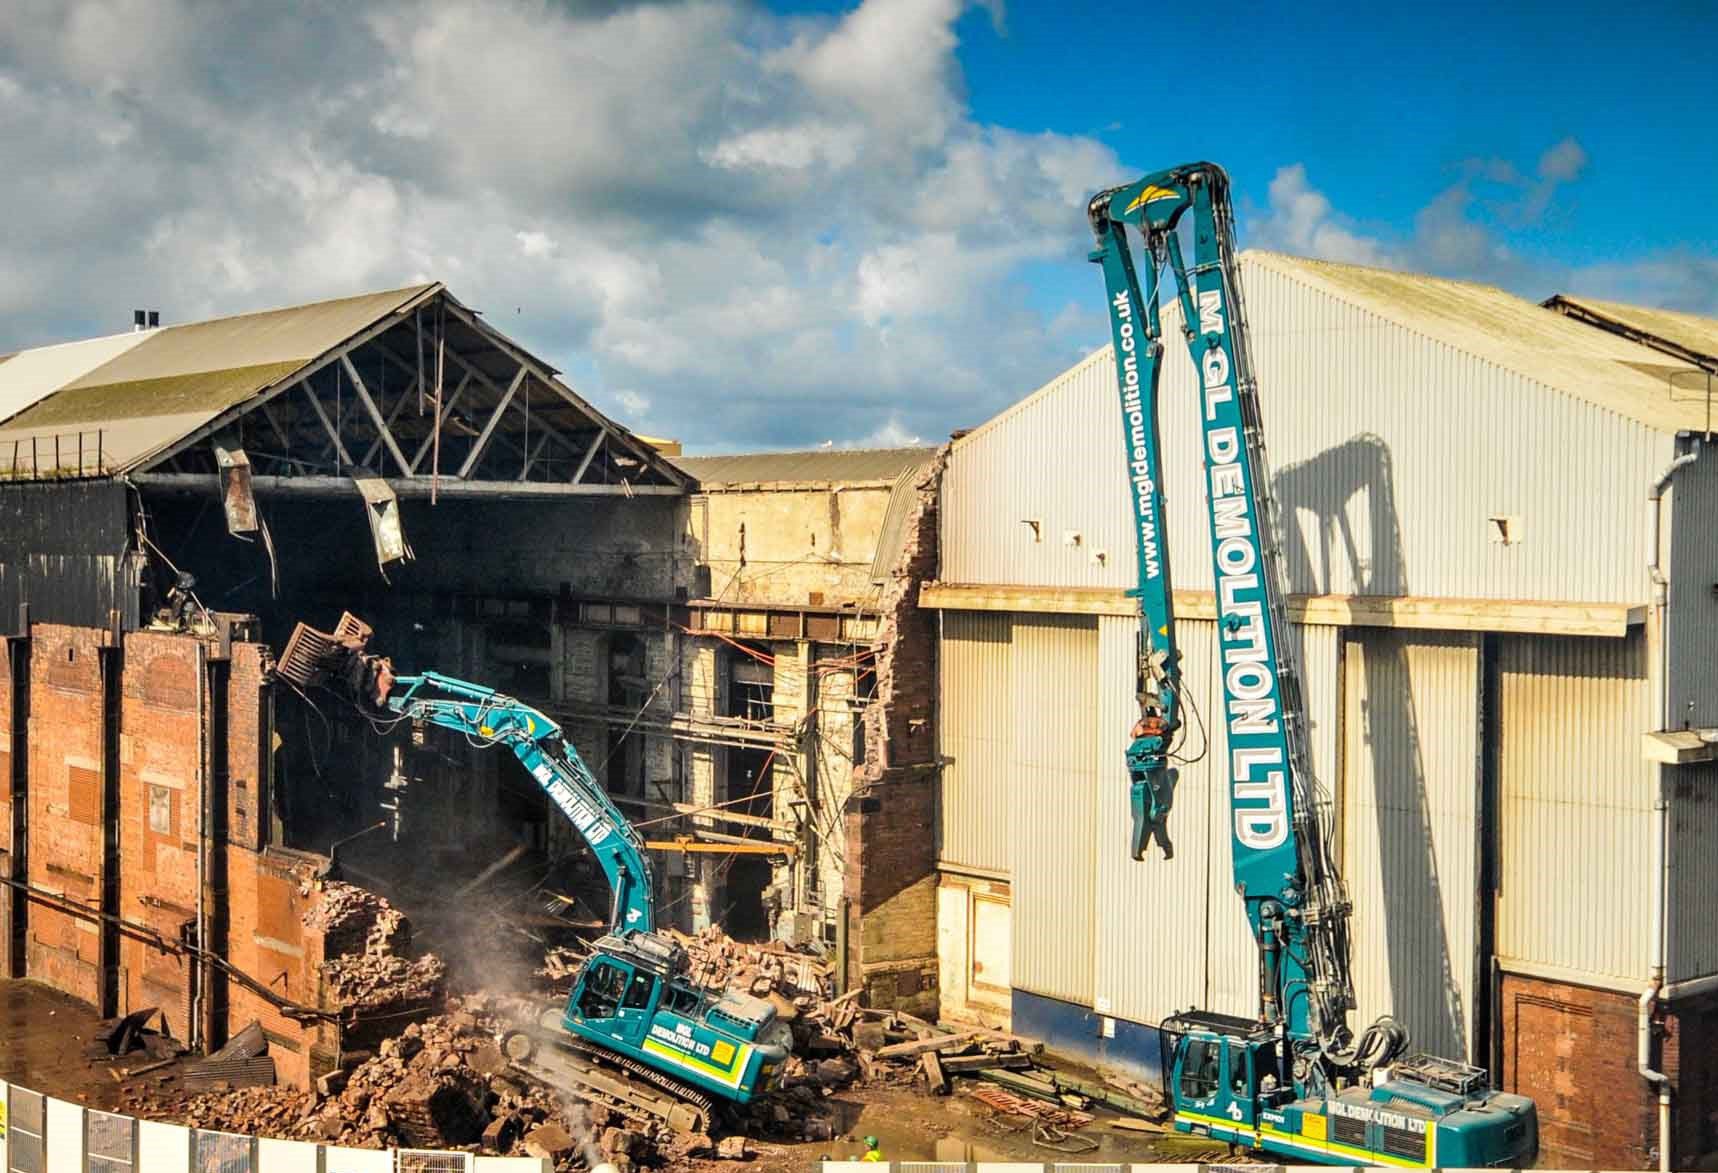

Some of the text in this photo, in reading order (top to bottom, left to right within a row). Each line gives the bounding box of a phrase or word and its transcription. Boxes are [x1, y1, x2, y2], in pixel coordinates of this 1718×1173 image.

[1113, 289, 1160, 580] www.mgldemolition.co.uk
[1199, 289, 1289, 850] MGL DEMOLITION LTD
[1407, 1117, 1426, 1134] LTD
